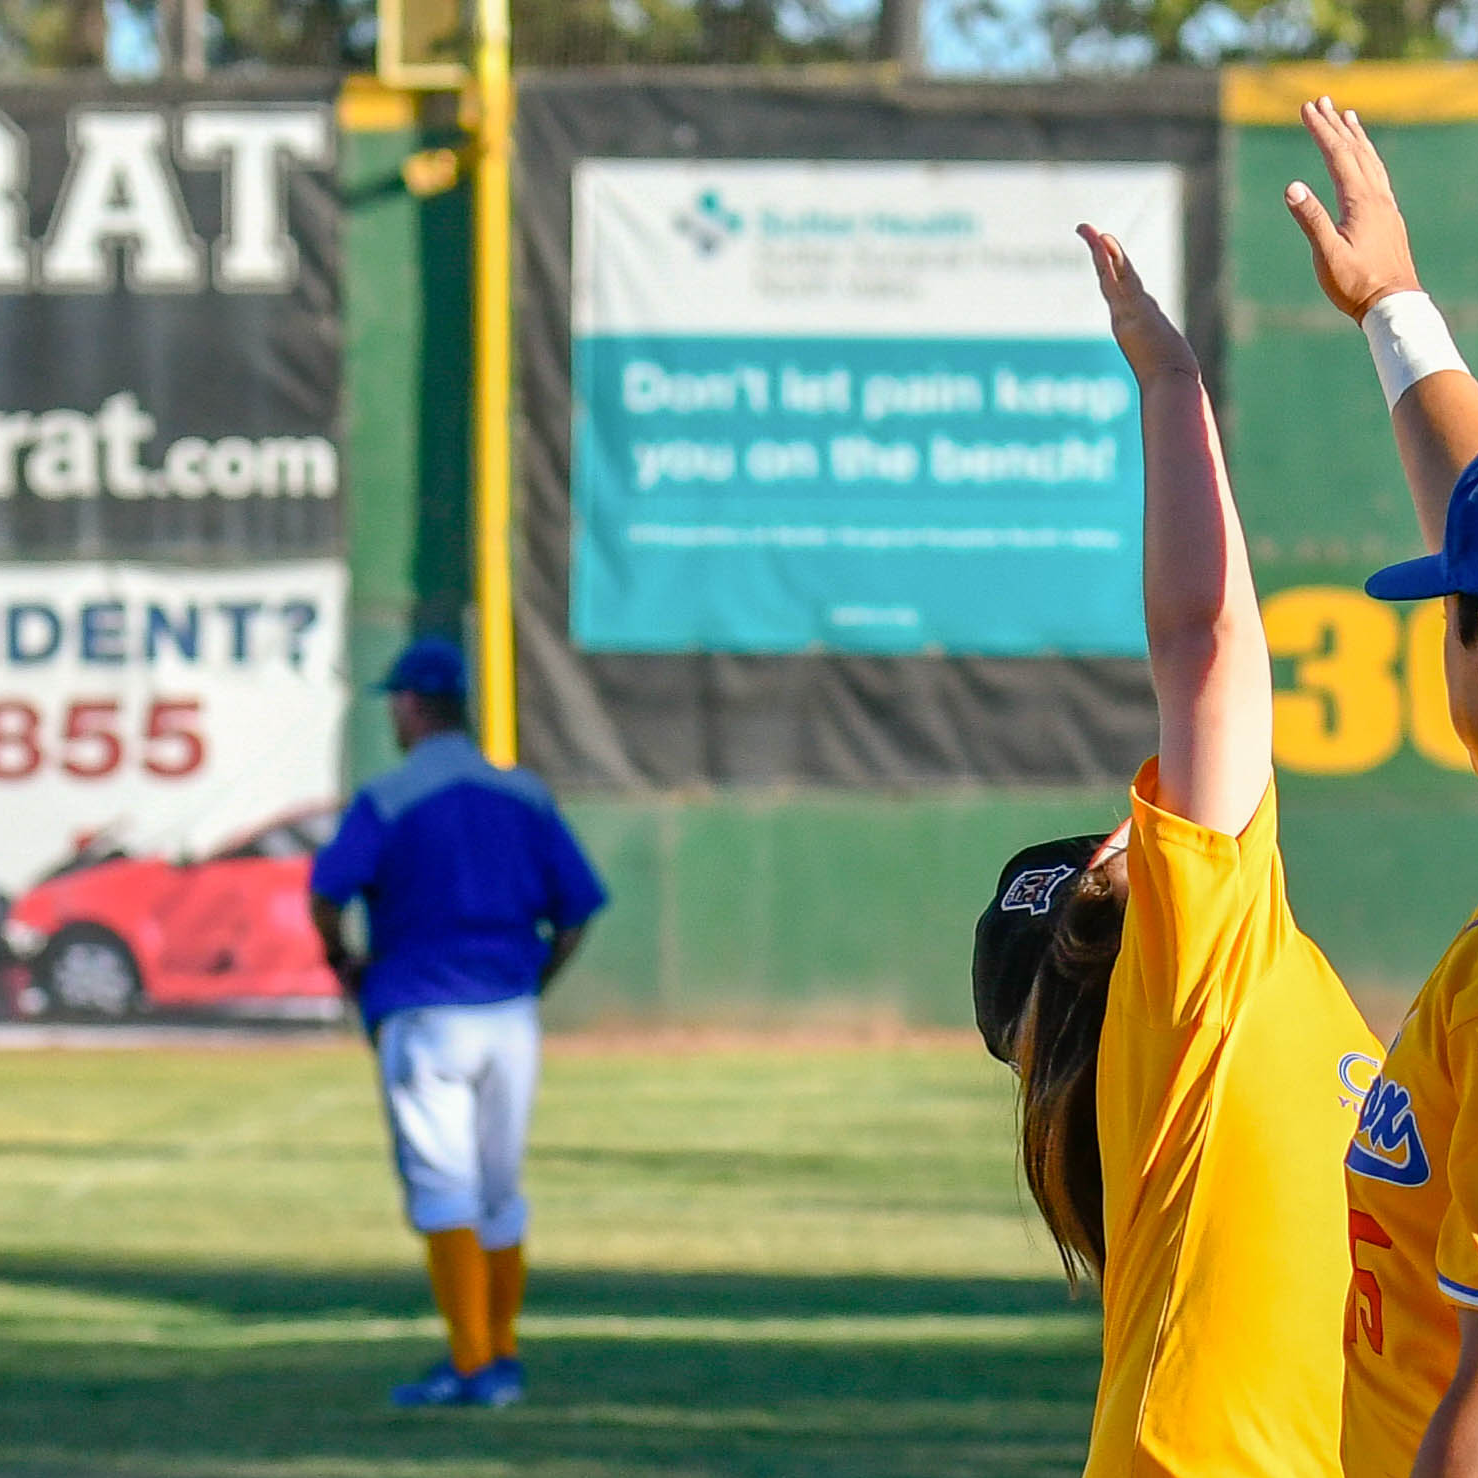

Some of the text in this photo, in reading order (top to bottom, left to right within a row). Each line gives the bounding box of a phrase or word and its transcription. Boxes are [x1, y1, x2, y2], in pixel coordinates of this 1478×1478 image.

[623, 360, 1125, 422] Don't let pain keep
[634, 440, 737, 490] you
[744, 440, 820, 482] on
[829, 436, 921, 482] the
